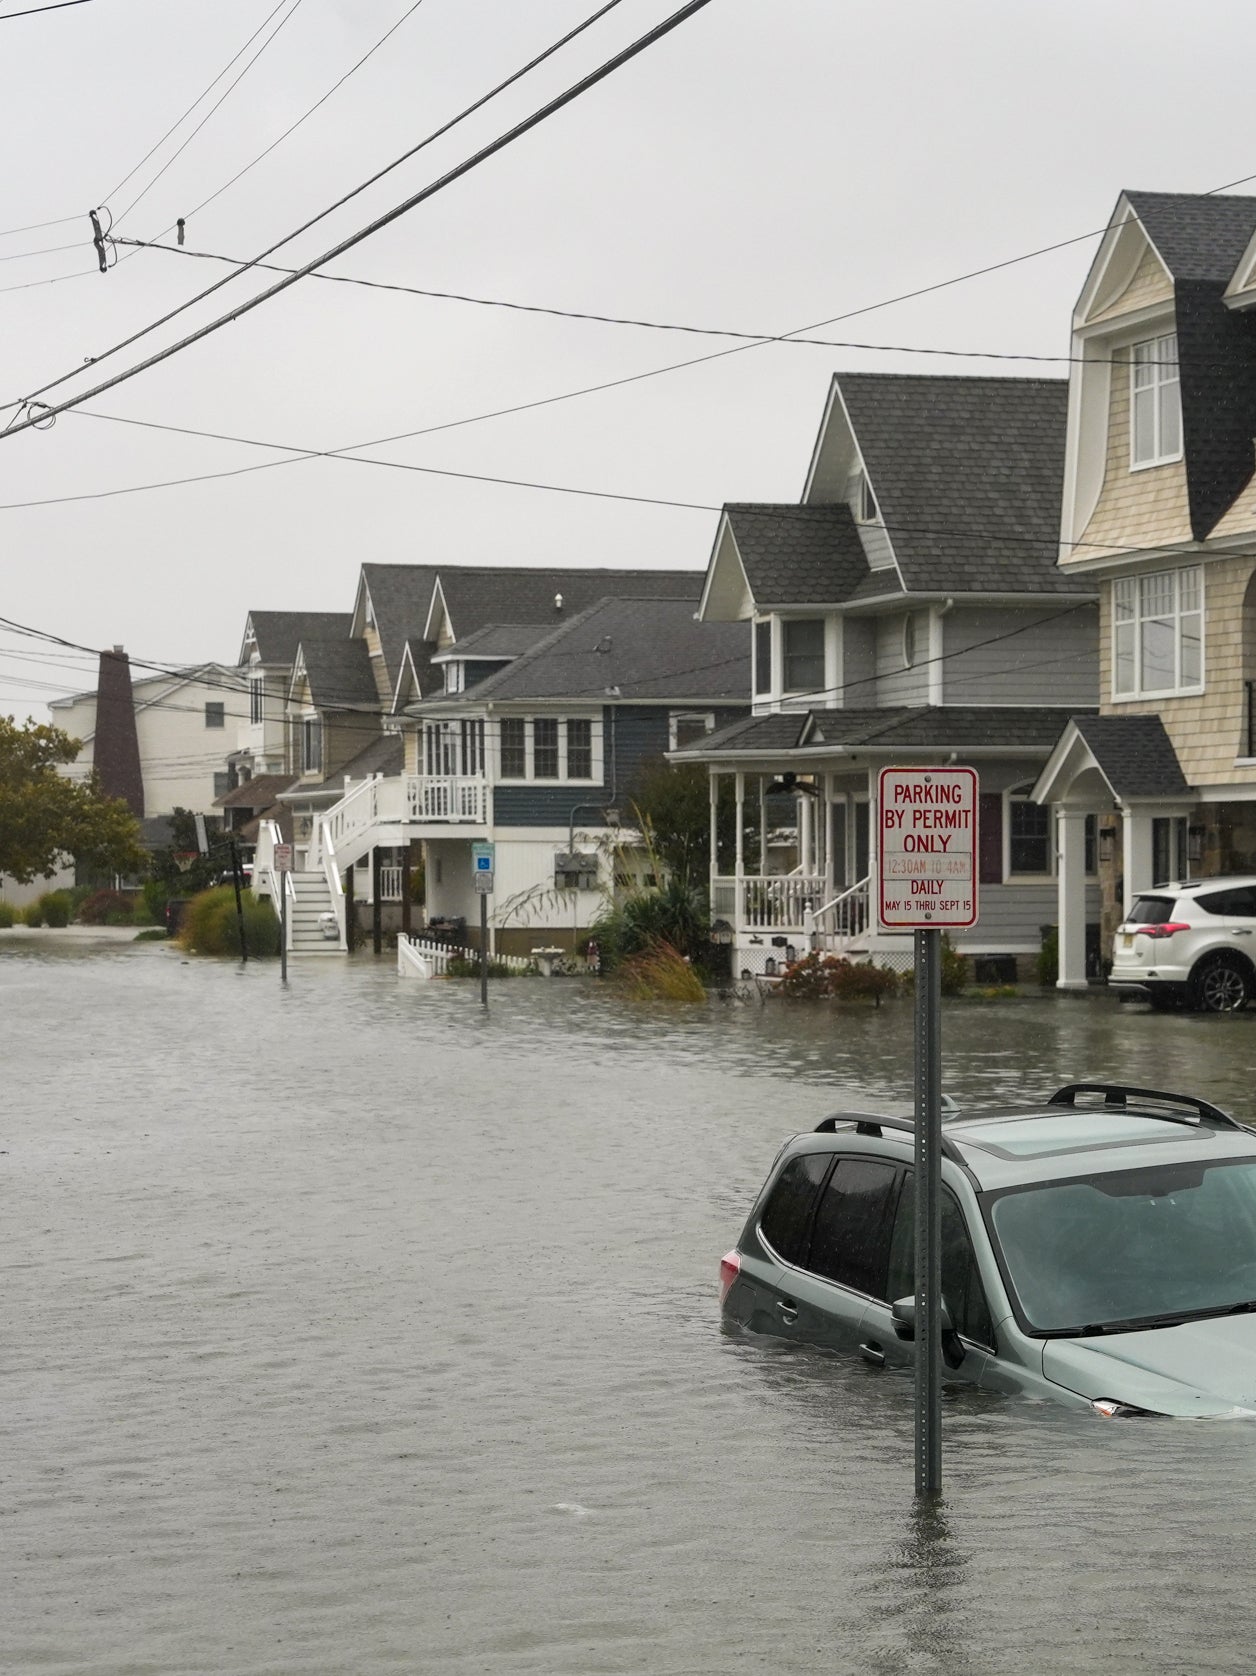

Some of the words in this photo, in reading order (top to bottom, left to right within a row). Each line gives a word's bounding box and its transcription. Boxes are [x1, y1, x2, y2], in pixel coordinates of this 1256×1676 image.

[895, 784, 962, 804] PARKING
[885, 809, 905, 829] BY
[913, 809, 971, 829] PERMIT
[904, 834, 952, 852] ONLY
[911, 880, 943, 894] DAILY
[885, 900, 900, 911] MAY
[904, 900, 912, 911] 15
[915, 900, 936, 911] THRU
[939, 900, 960, 911] SEPT
[963, 900, 971, 911] 15
